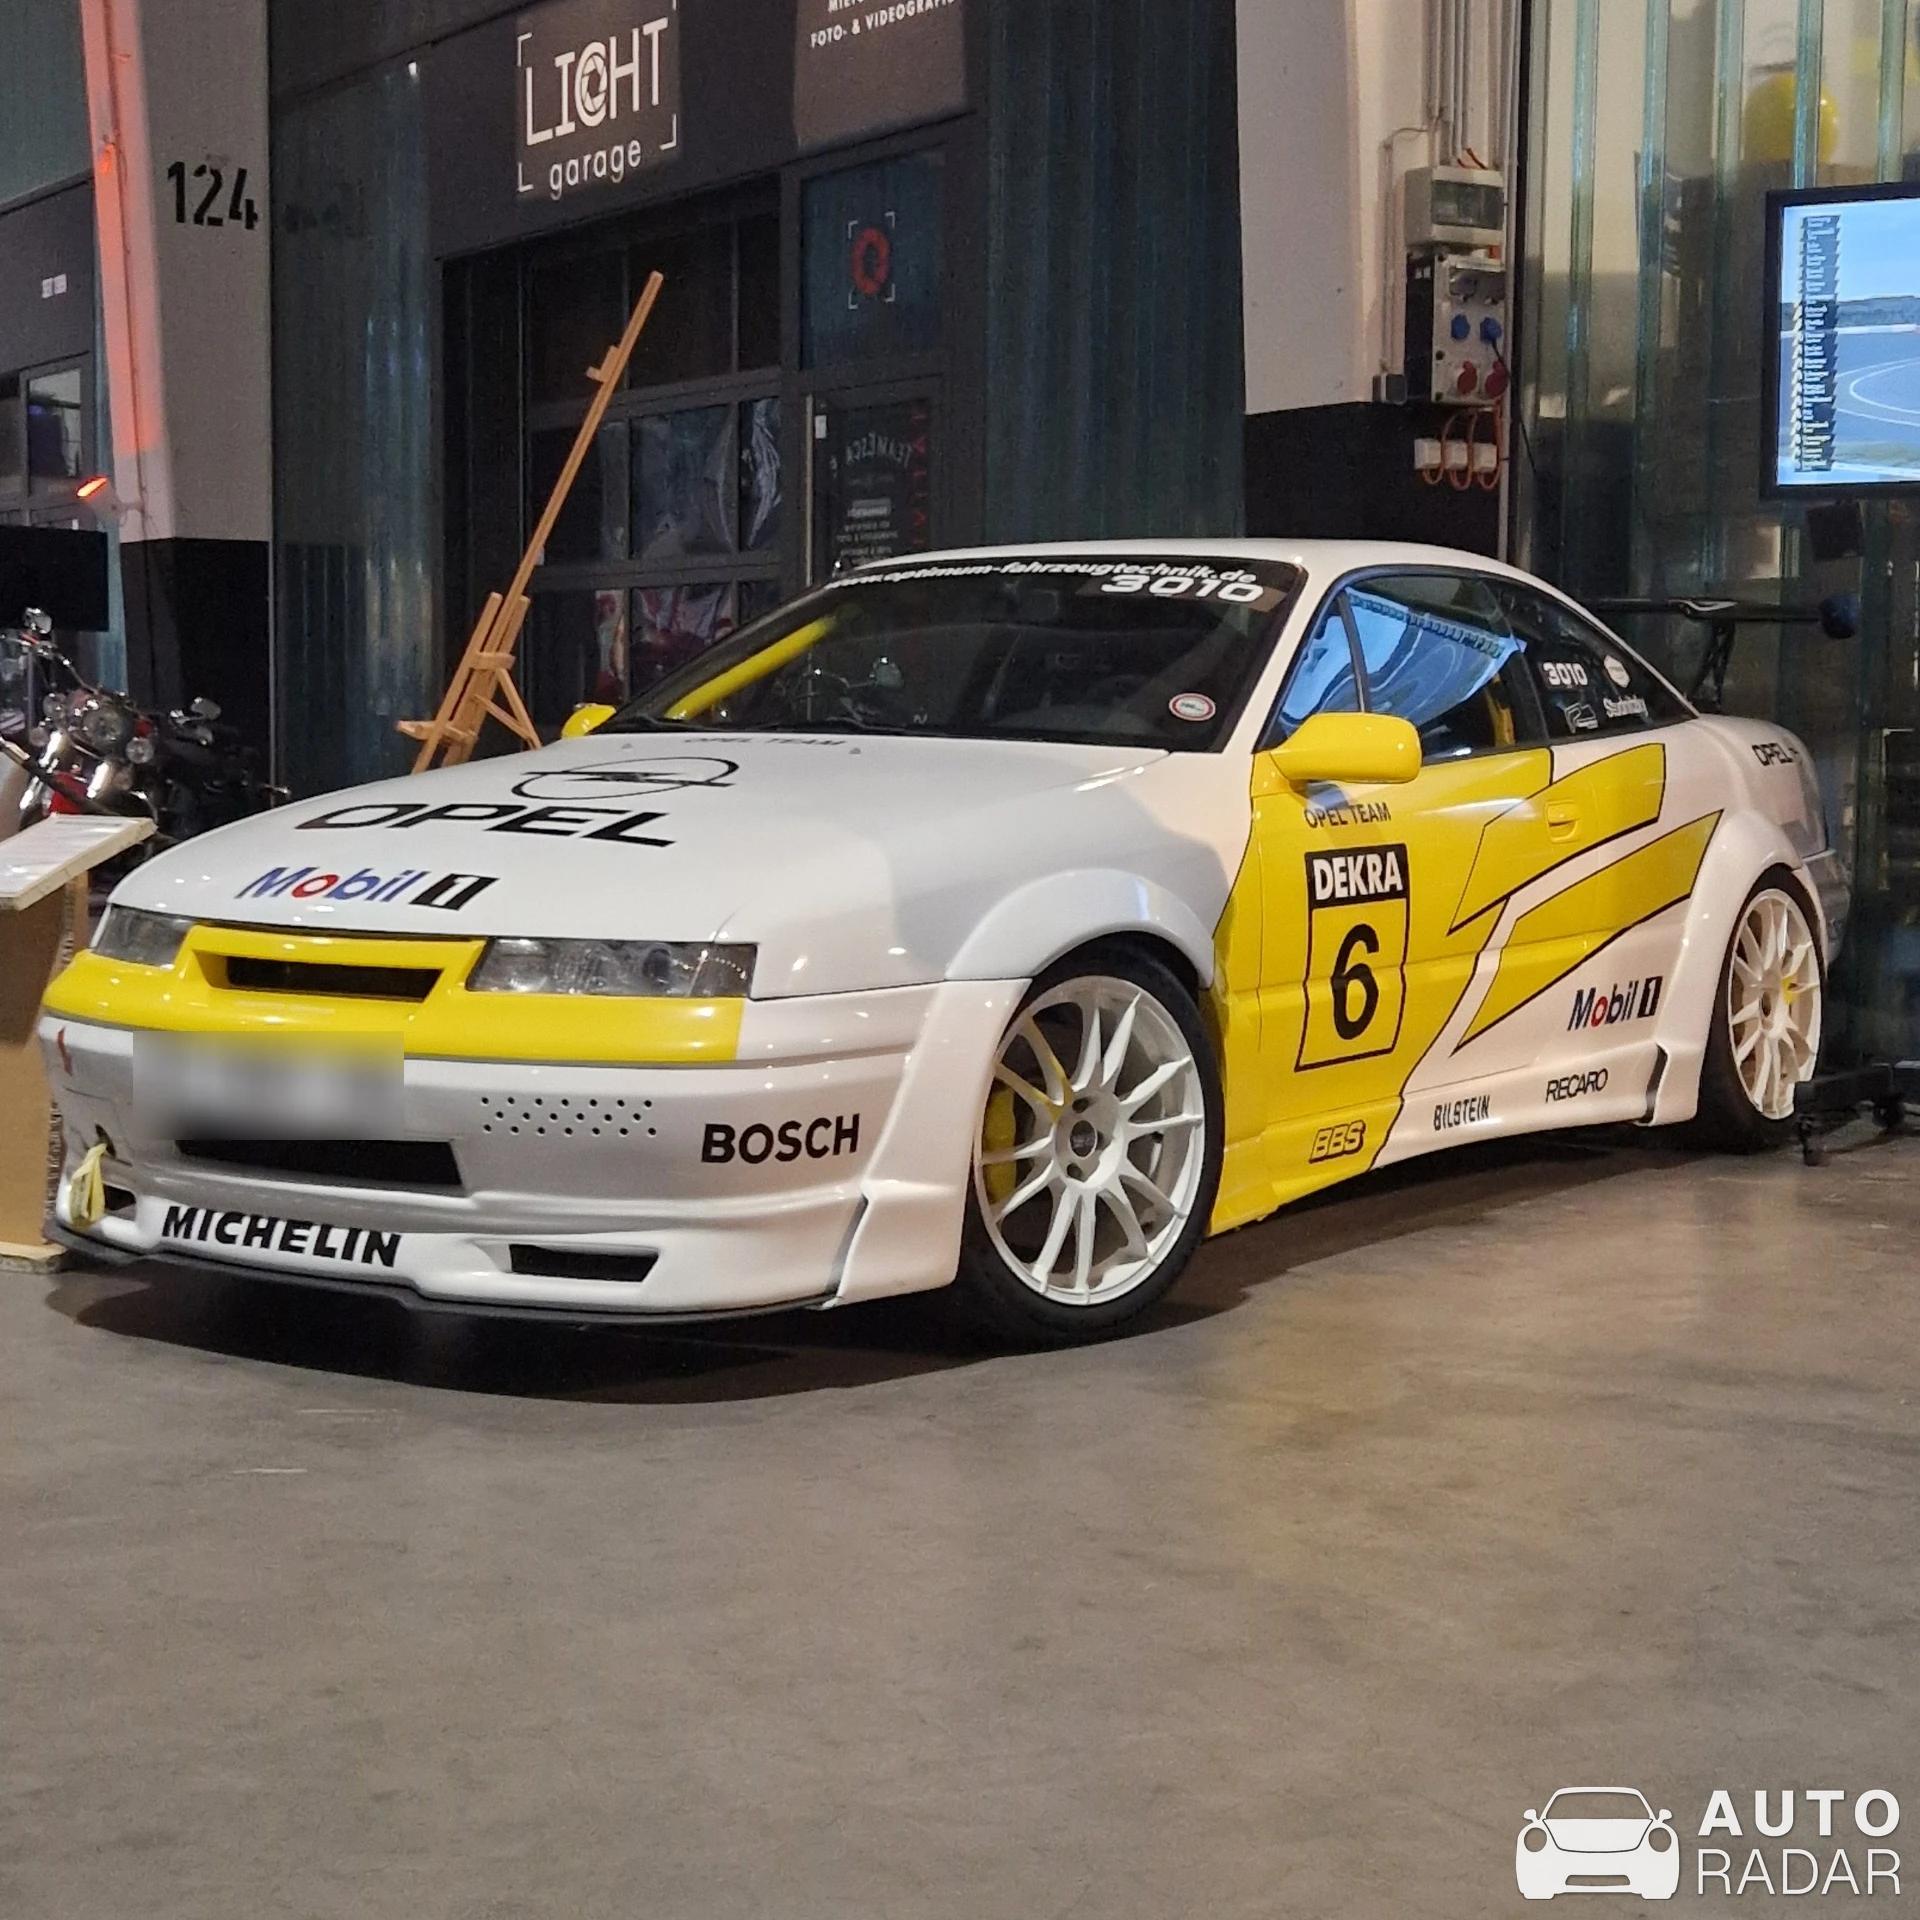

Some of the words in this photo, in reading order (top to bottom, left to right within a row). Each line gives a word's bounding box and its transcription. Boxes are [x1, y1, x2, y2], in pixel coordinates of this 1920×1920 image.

[810, 24, 848, 48] FOTO-
[851, 18, 861, 35] &
[526, 17, 668, 146] LICHT
[550, 140, 641, 200] garage
[167, 161, 258, 230] 124
[1101, 574, 1263, 602] 3010
[1543, 662, 1588, 686] 3010
[1752, 742, 1793, 766] OPEL
[295, 803, 676, 848] OPEL
[1304, 806, 1348, 828] OPEL
[1350, 802, 1391, 825] TEAM
[233, 867, 431, 902] Mobil
[1312, 851, 1403, 900] DEKRA
[1331, 923, 1379, 1040] 6
[1567, 979, 1639, 1031] Mobil
[1545, 1068, 1608, 1103] RECARO
[1433, 1094, 1490, 1131] BILSTEIN
[701, 1113, 860, 1164] BOSCH
[1308, 1119, 1366, 1164] BBS
[161, 1206, 402, 1267] MICHELIN
